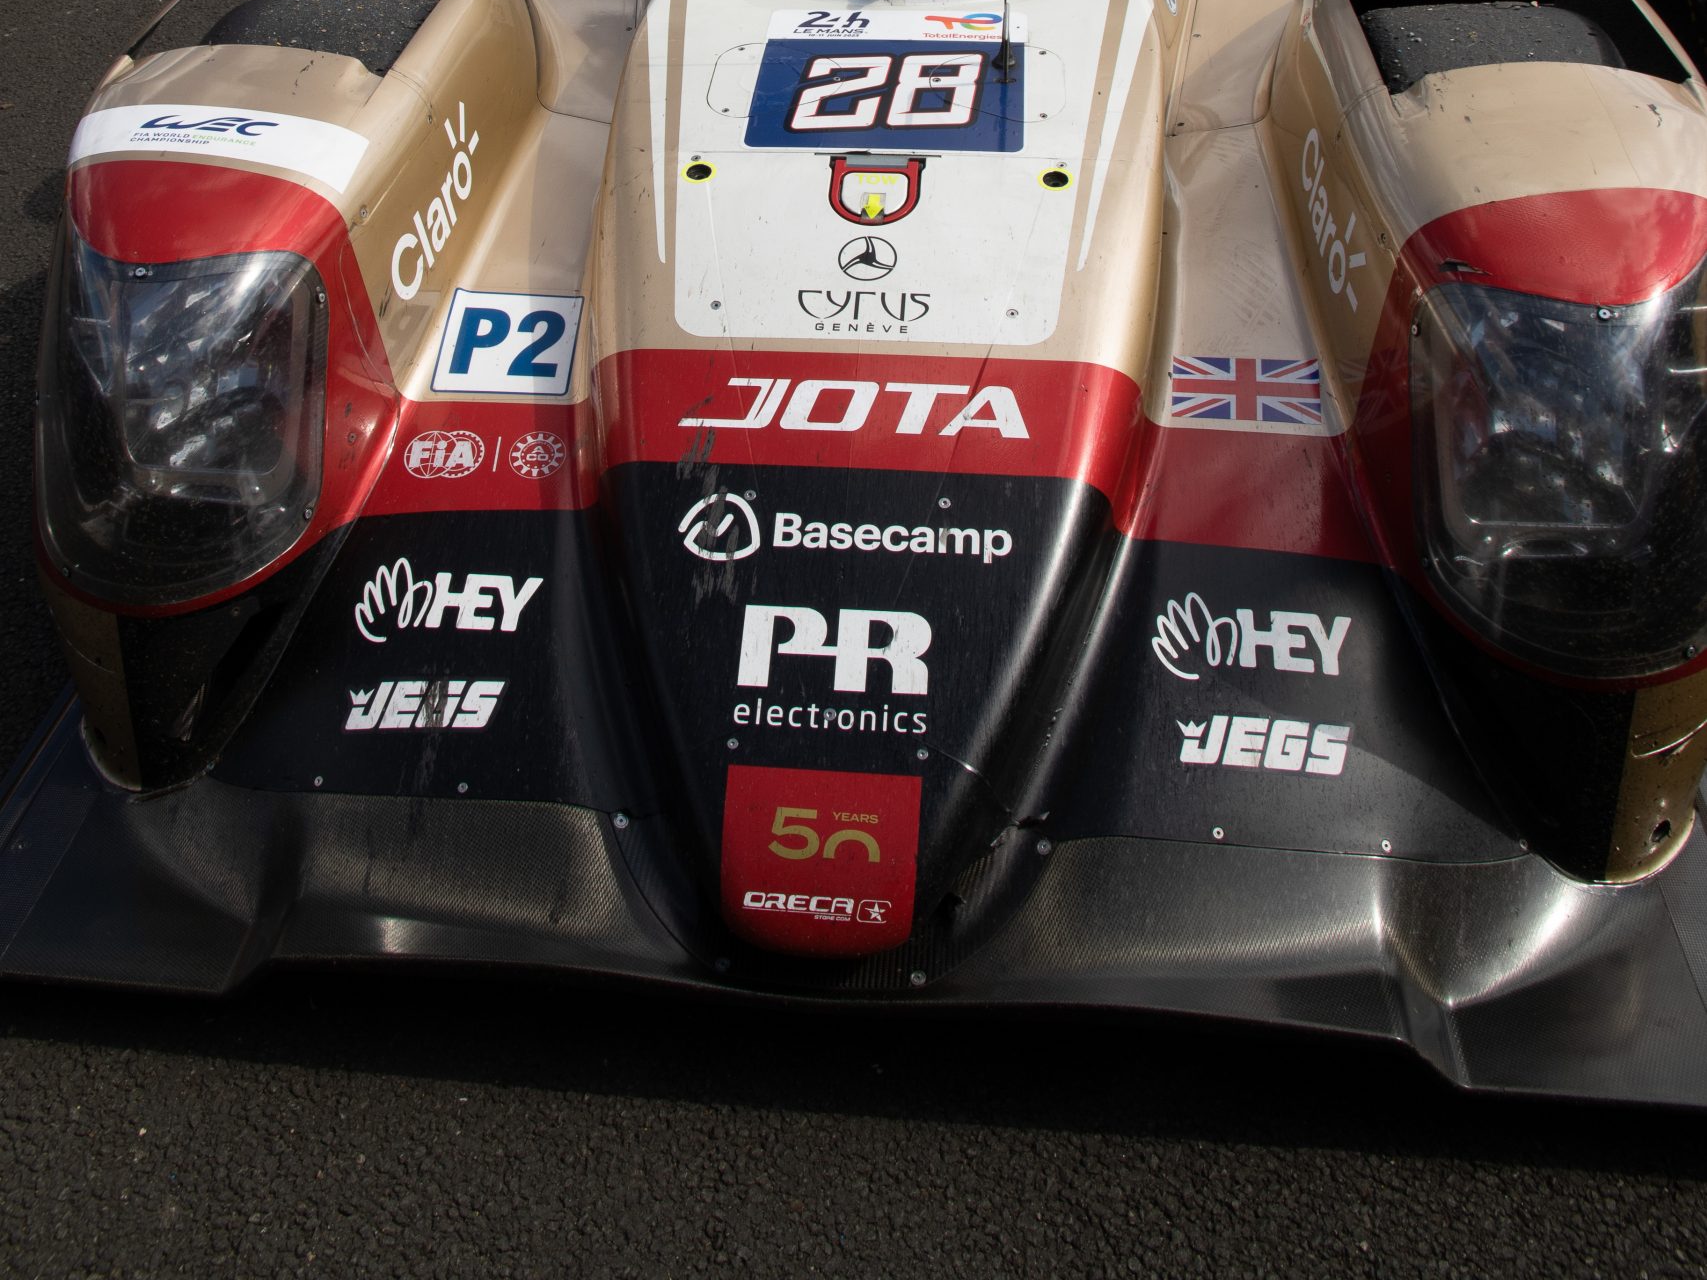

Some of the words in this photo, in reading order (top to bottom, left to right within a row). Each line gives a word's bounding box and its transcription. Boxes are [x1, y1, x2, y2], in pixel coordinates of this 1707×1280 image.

[798, 11, 870, 28] 24h
[923, 32, 1002, 40] TotalEnergies
[789, 53, 984, 131] 28
[129, 136, 210, 145] CHAMPIONSHIP
[140, 114, 280, 137] WEC
[192, 134, 257, 146] ENDURANCE
[854, 173, 899, 185] TOW
[391, 150, 473, 301] Claro
[1301, 127, 1347, 295] Claro
[448, 307, 566, 378] P2
[815, 321, 908, 334] GENÈVE
[677, 377, 1030, 439] JOTA
[772, 512, 1013, 564] Basecamp
[425, 572, 544, 632] HEY
[736, 604, 933, 695] PR
[1236, 608, 1352, 676] HEY
[345, 681, 506, 730] JEGS
[1179, 714, 1351, 776] JEGS
[832, 811, 879, 825] YEARS
[742, 891, 855, 914] ORECA
